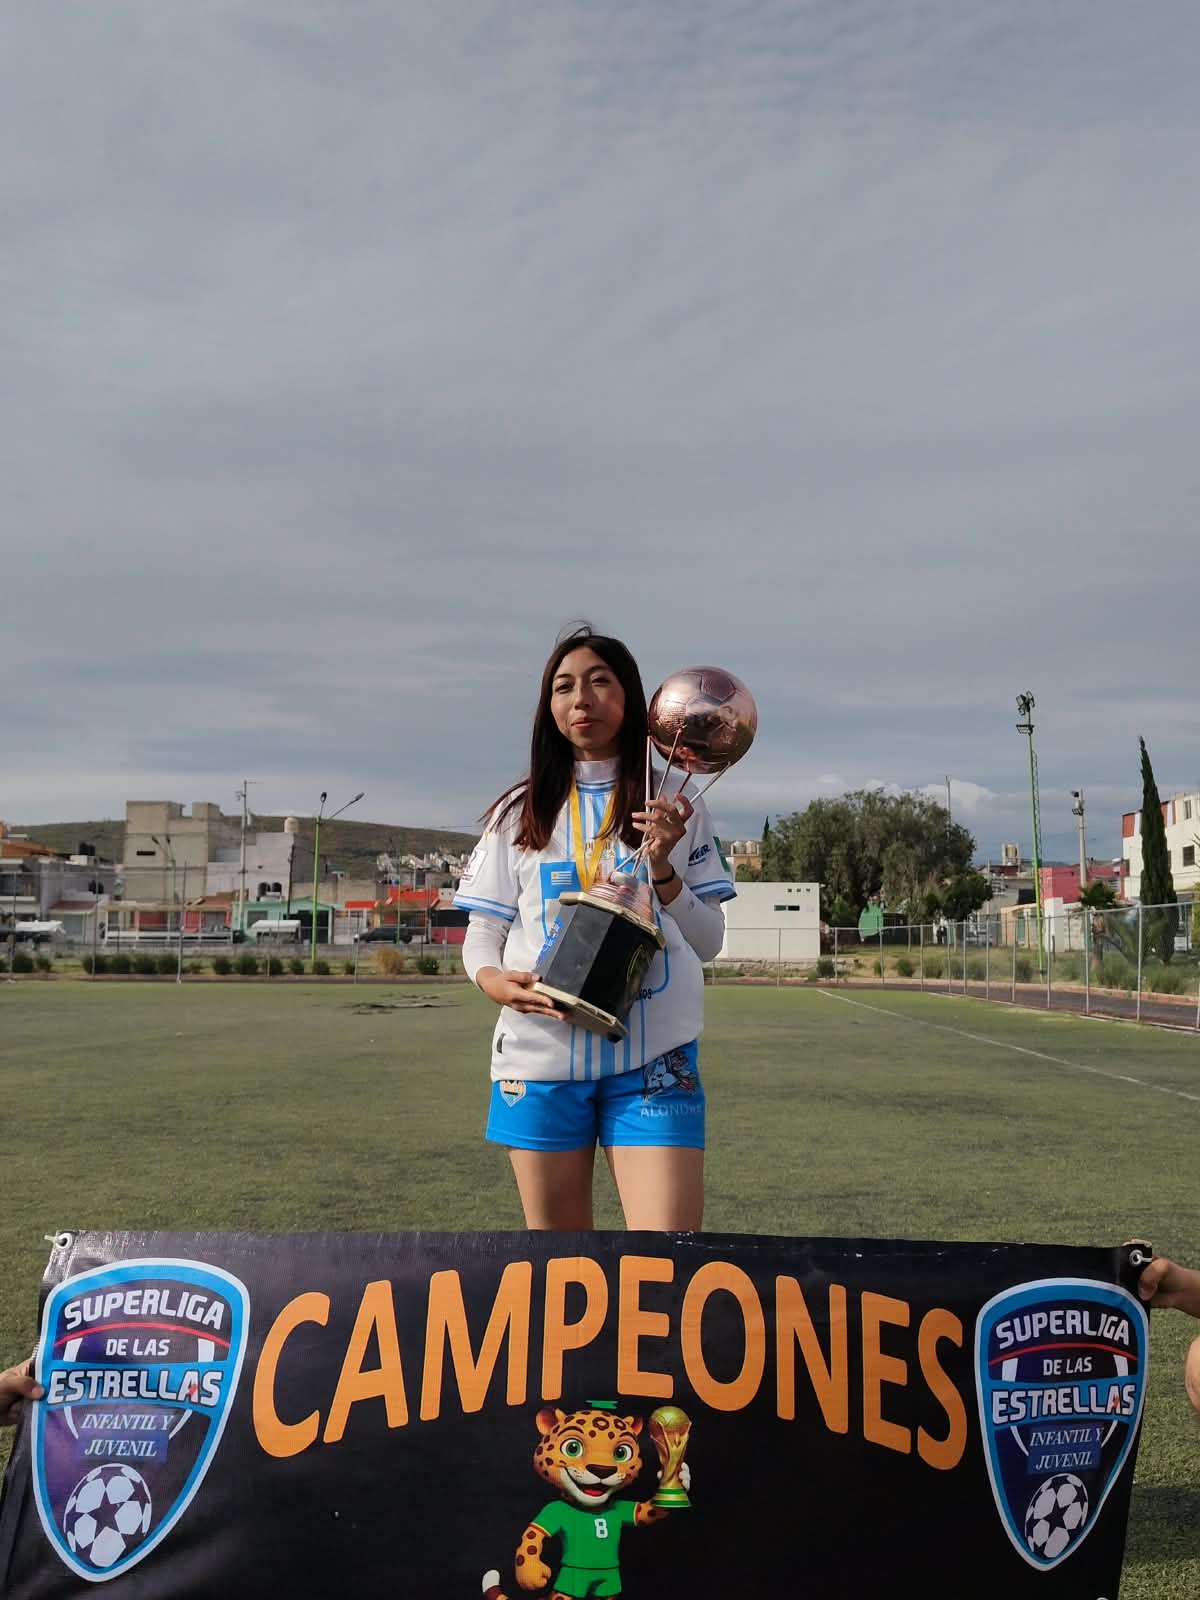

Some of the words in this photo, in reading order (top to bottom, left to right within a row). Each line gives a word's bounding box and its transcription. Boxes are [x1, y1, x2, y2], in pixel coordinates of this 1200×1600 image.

[64, 1290, 224, 1329] SUPERLIGA
[996, 1310, 1129, 1349] SUPERLIGA
[106, 1339, 129, 1356] DE
[133, 1339, 170, 1356] LAS
[252, 1255, 968, 1470] CAMPEONES
[1043, 1358, 1061, 1376] DE
[1066, 1356, 1092, 1374] LAS
[48, 1370, 222, 1405] ESTRELLAS
[992, 1385, 1135, 1424] ESTRELLAS
[81, 1413, 161, 1431] INFANTIL
[161, 1415, 174, 1431] Y
[1029, 1429, 1093, 1447] INFANTIL
[1093, 1428, 1103, 1443] Y
[84, 1439, 158, 1457] JUVENIL
[1037, 1452, 1093, 1470] JUVENIL
